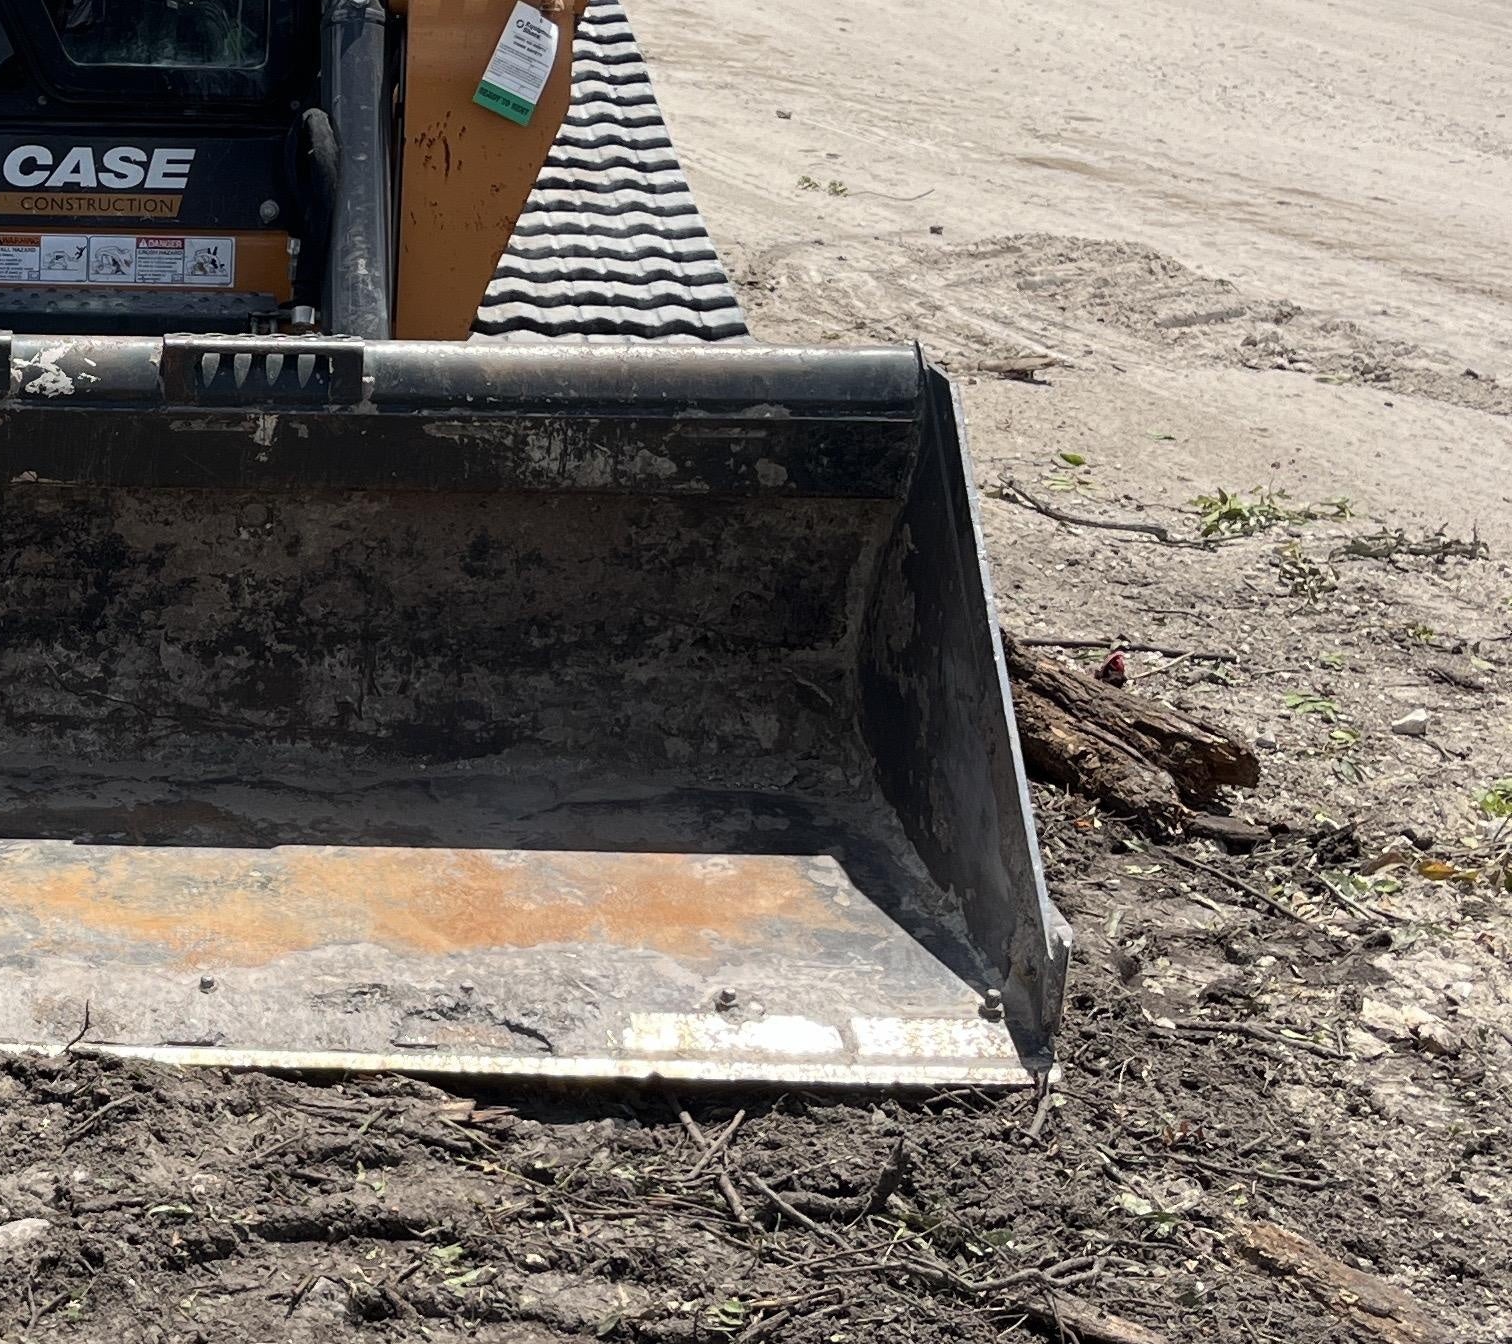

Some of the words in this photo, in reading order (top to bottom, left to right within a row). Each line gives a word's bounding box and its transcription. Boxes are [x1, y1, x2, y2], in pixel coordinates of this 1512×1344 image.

[3, 145, 196, 189] CASE
[20, 196, 174, 213] CONSTRUCTION
[148, 239, 183, 249] DANGER
